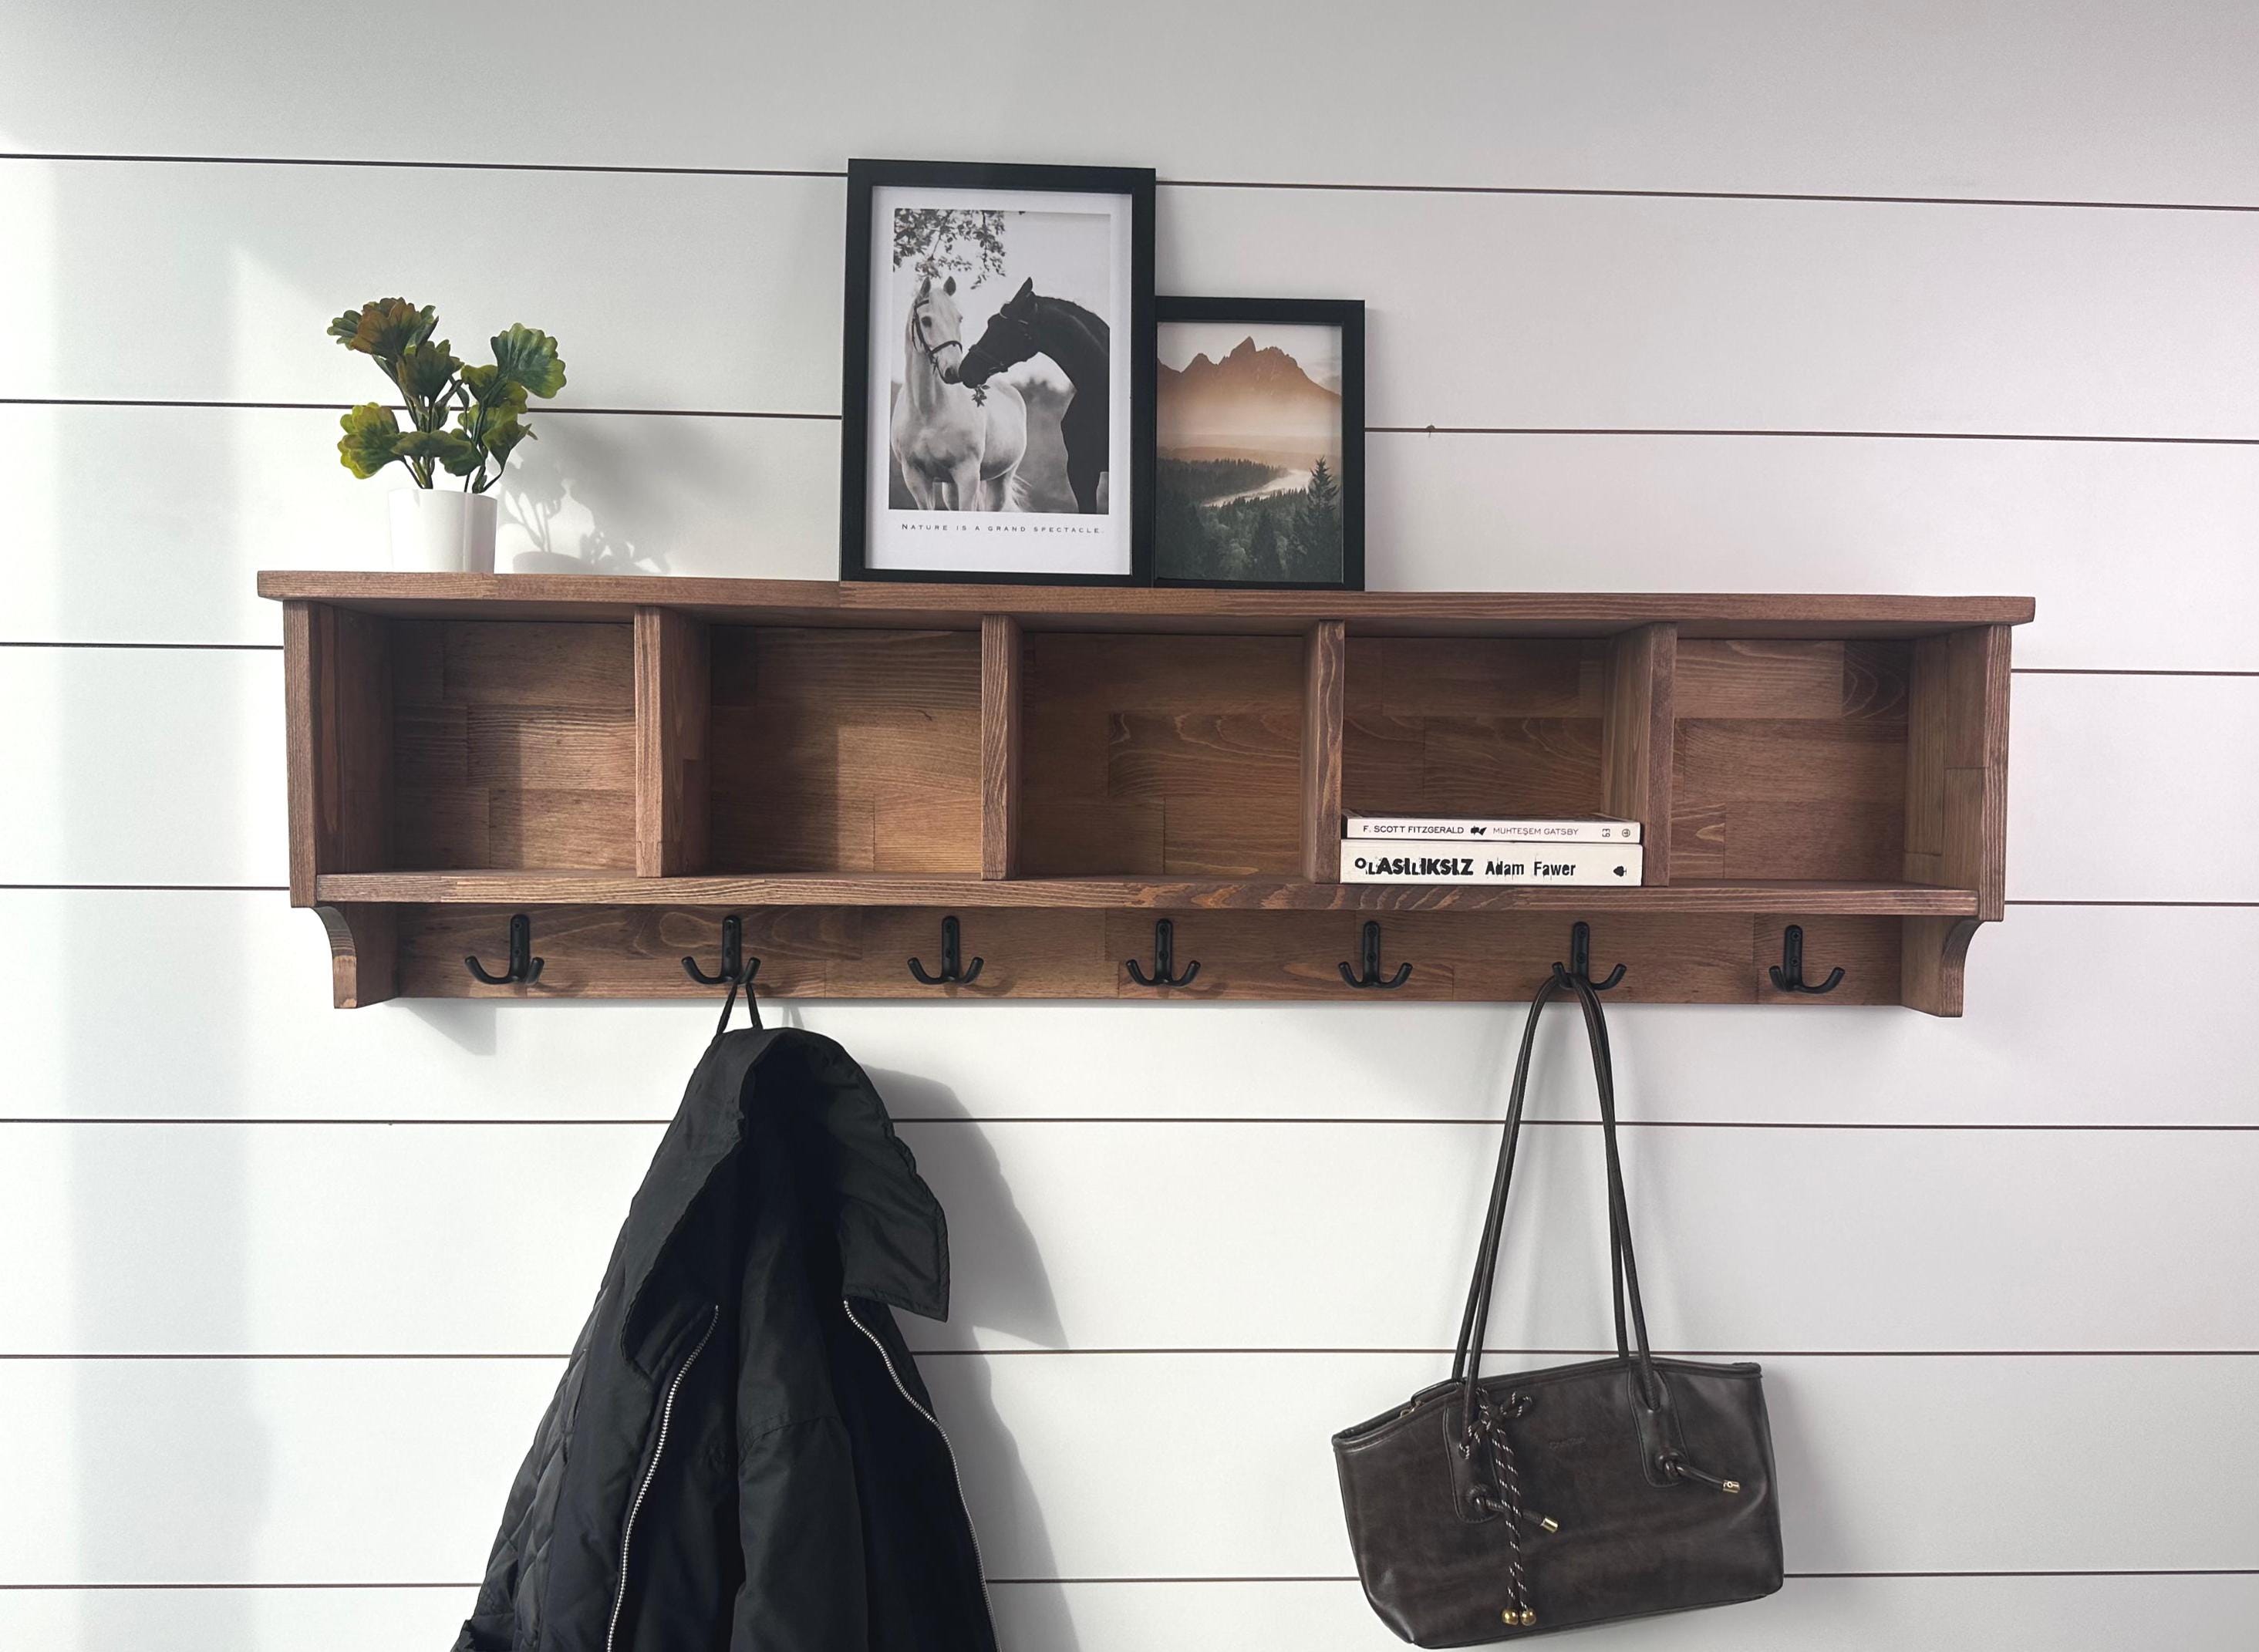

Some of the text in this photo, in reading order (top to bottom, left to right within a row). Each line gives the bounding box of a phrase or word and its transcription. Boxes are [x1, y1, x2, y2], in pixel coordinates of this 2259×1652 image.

[1408, 826, 1465, 834] FITZGERALD
[1492, 828, 1542, 836] MUHTEŞEM
[1354, 857, 1474, 876] OLASILIKSIZ
[1485, 860, 1576, 876] Adam Fawer
